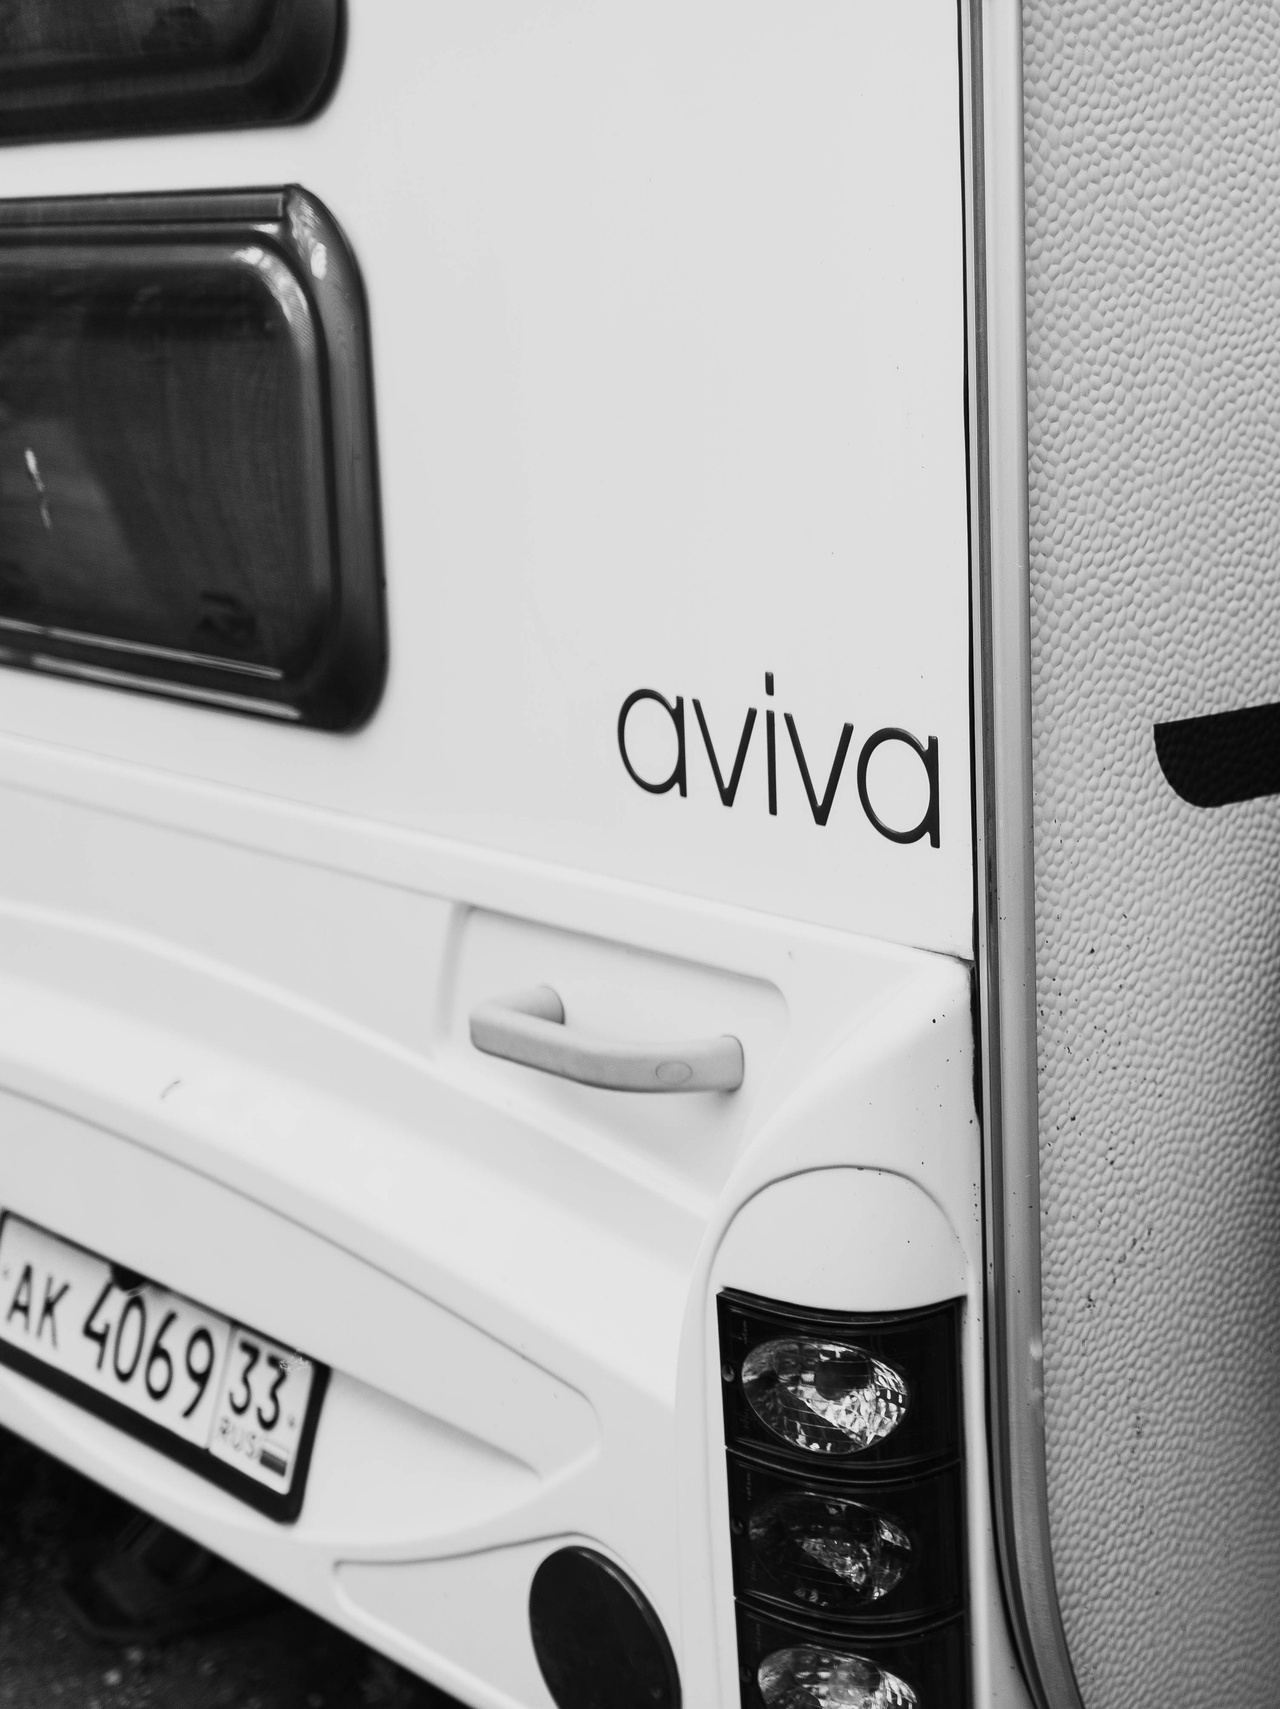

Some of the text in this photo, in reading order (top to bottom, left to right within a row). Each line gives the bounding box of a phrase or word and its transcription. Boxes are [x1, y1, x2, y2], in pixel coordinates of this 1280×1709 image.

[617, 671, 941, 849] aviva
[7, 1263, 288, 1431] AK 4069 33
